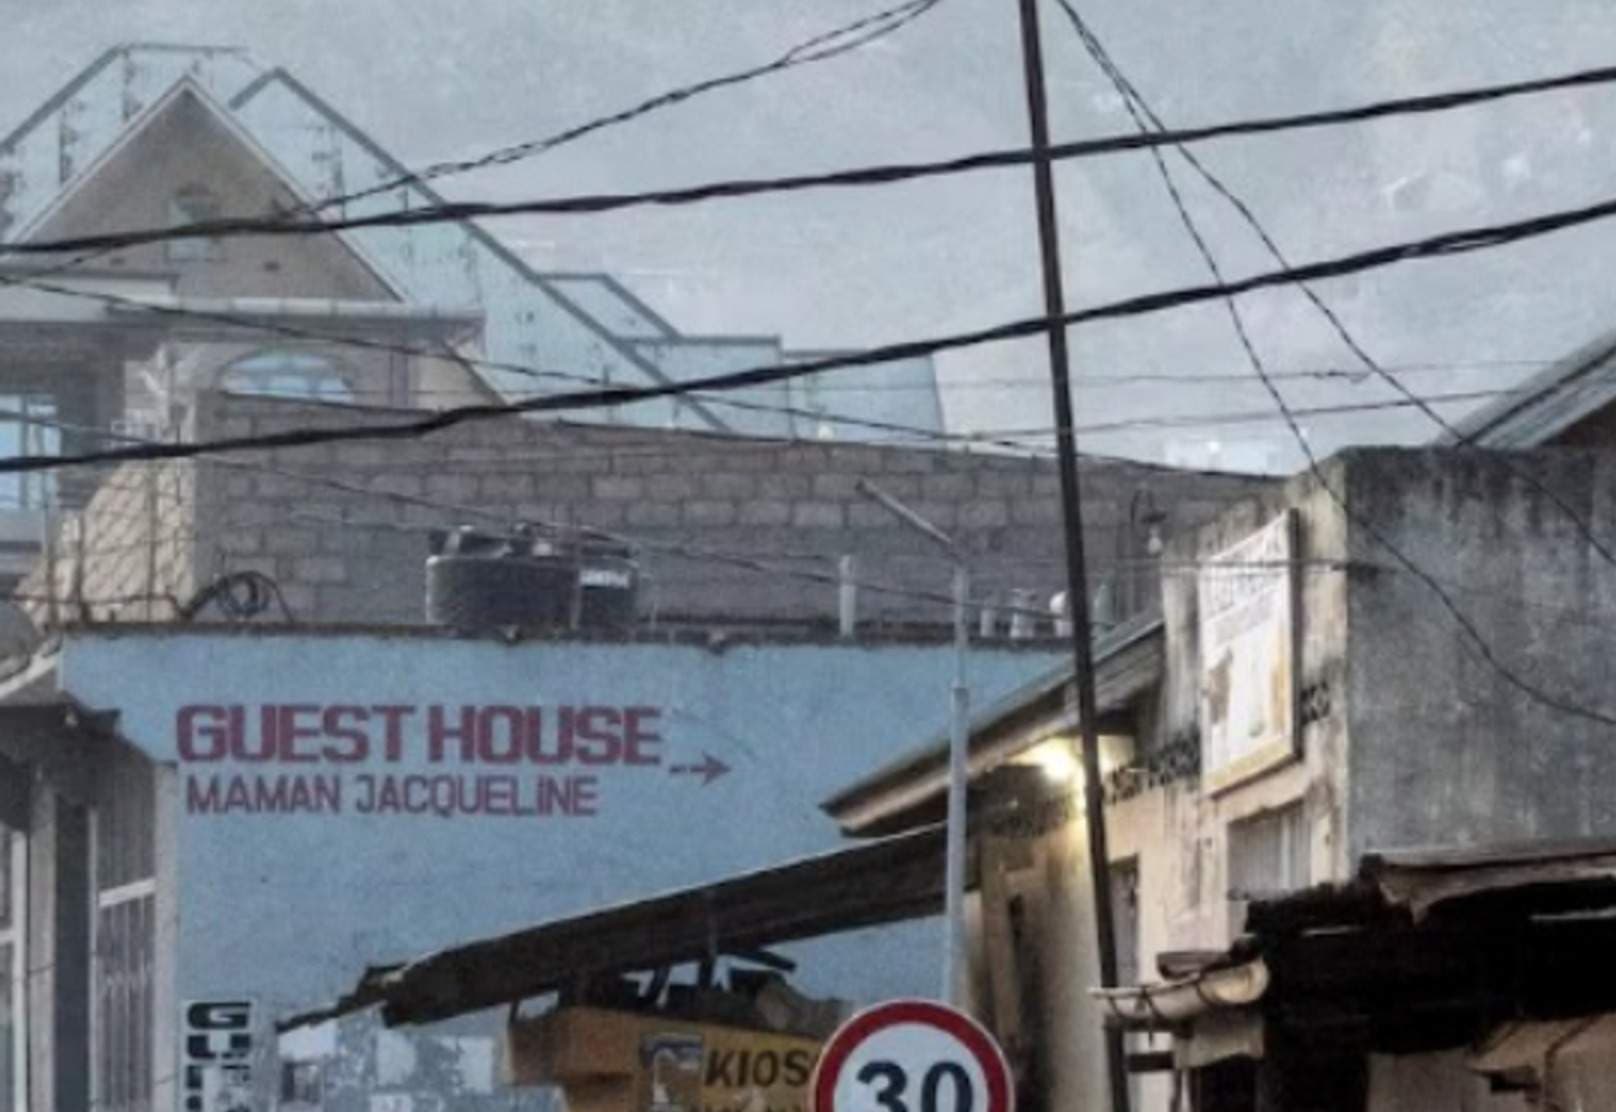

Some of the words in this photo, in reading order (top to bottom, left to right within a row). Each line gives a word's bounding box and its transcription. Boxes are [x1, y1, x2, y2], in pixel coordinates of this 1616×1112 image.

[176, 704, 415, 763] GUEST
[428, 704, 662, 766] HOUSE
[186, 772, 342, 815] MAMAN
[704, 1048, 818, 1087] KIOS
